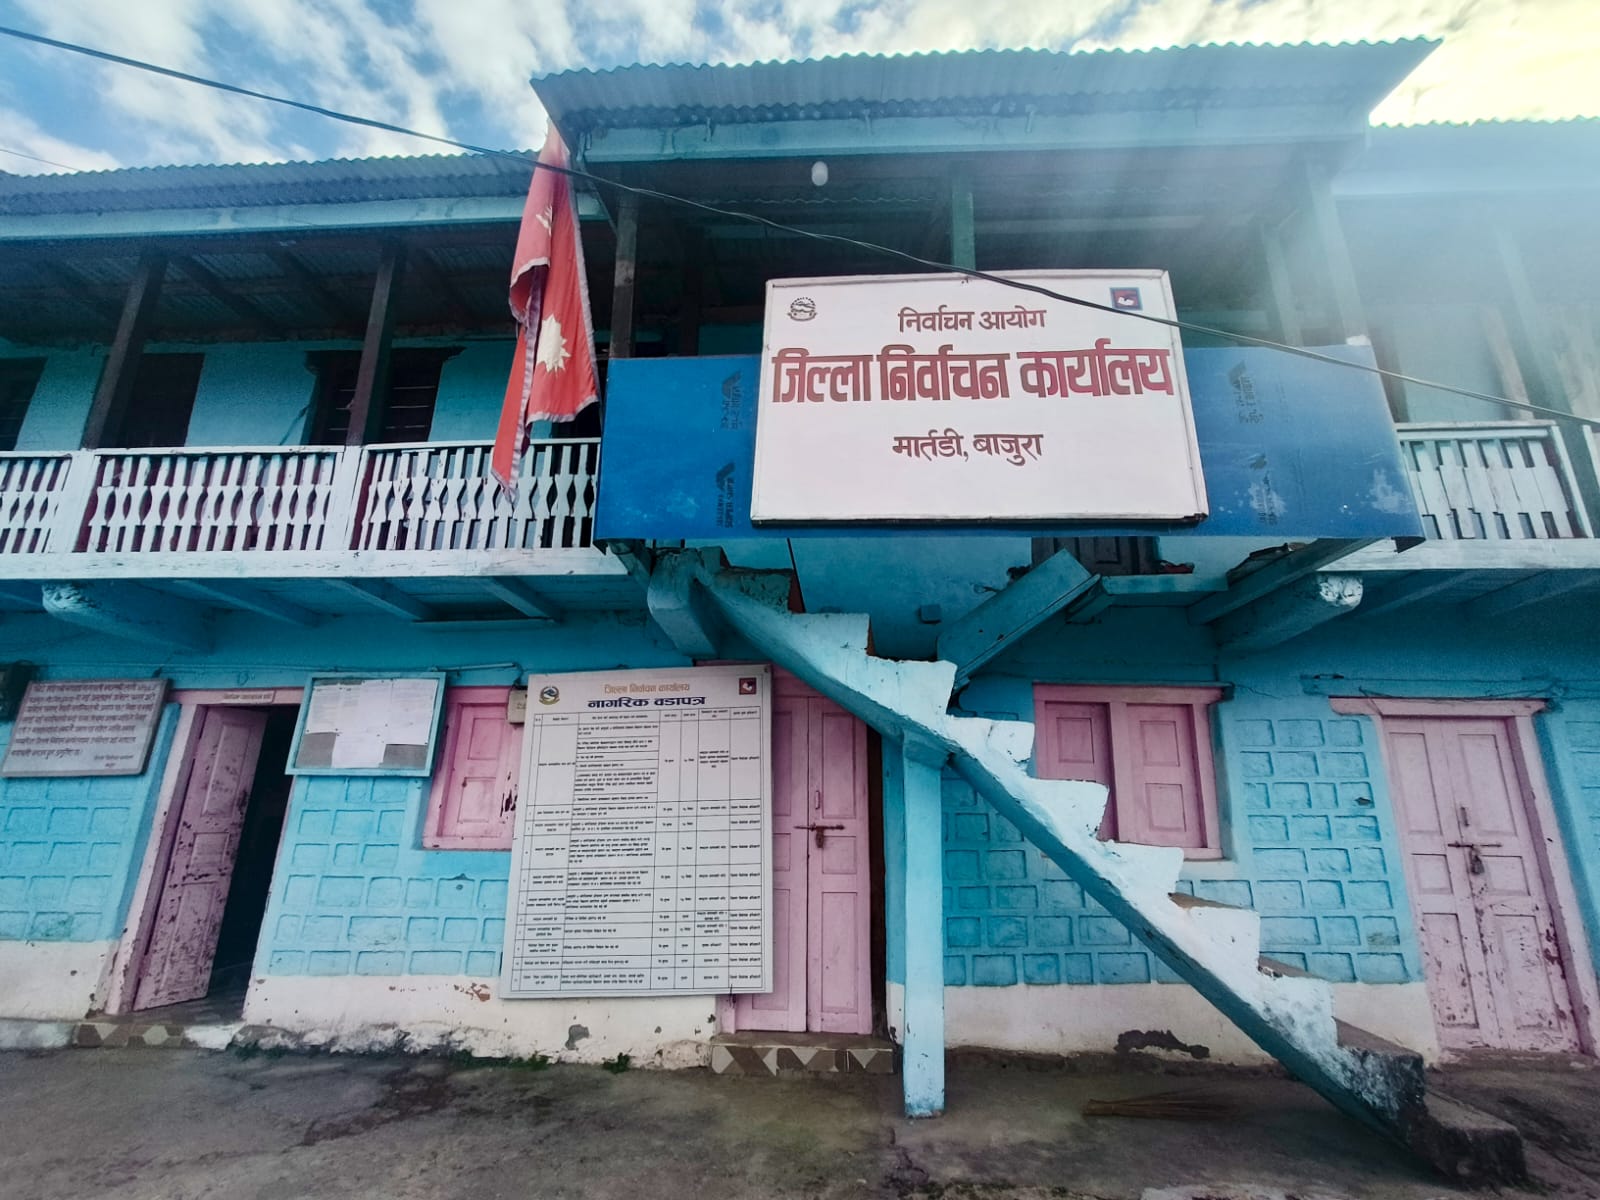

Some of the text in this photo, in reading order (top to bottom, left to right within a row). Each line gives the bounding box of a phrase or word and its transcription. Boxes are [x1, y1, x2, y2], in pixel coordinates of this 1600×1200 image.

[898, 304, 1047, 333] निर्वाचन आयोग
[771, 337, 1174, 403] जिल्ला निर्वाचन कार्यालय
[973, 433, 1044, 467] बाजुरा
[588, 695, 707, 708] नागरिक वडापत्र
